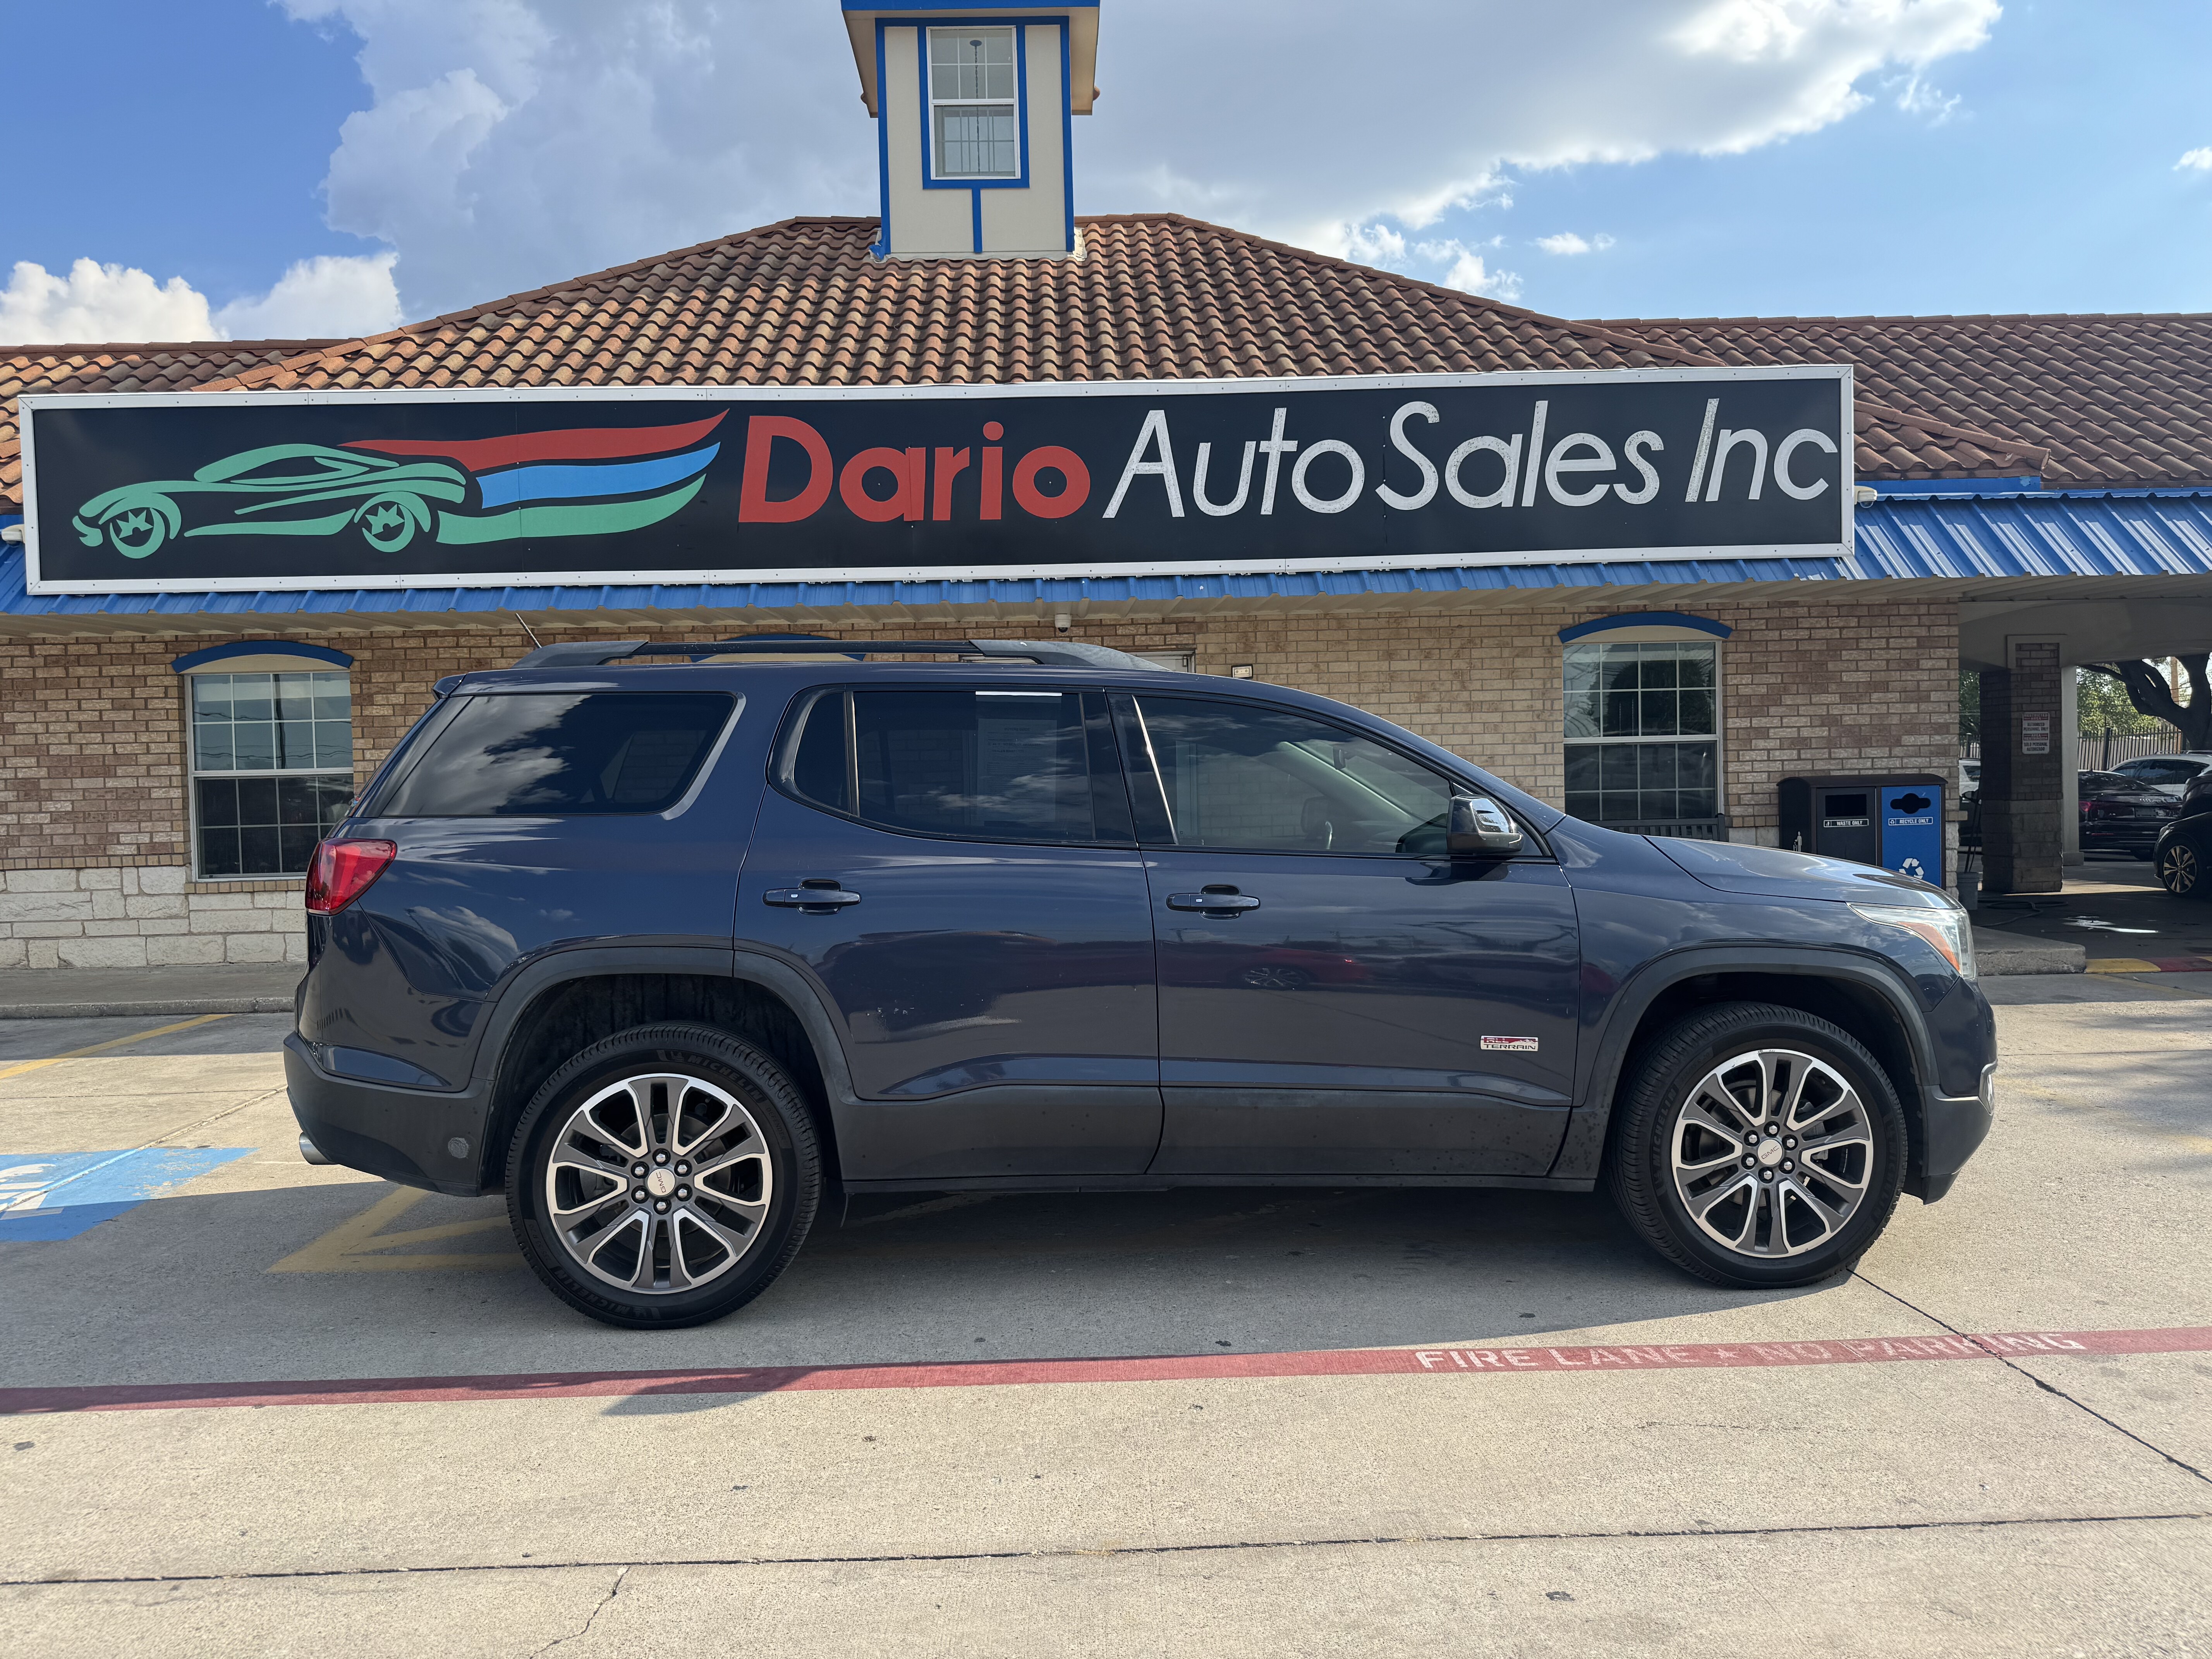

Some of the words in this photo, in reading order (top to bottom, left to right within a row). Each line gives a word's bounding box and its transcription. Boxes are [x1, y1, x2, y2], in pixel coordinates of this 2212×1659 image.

[738, 416, 1091, 523] Dario
[1102, 407, 1365, 518] Auto
[1375, 400, 1664, 510] Sales
[1685, 398, 1838, 503] Inc
[688, 1054, 763, 1102] MICHELIN
[766, 1108, 787, 1140] DEFENDER
[1652, 1087, 1678, 1167] MICHELIN
[1761, 1145, 1780, 1160] GMC
[656, 1171, 666, 1193] GMC
[554, 1267, 629, 1315] MICHELIN
[1415, 1349, 1540, 1369] FIRE
[1549, 1346, 1700, 1366] LANE
[1753, 1342, 1832, 1362] NO
[1855, 1333, 2087, 1358] PARKING
